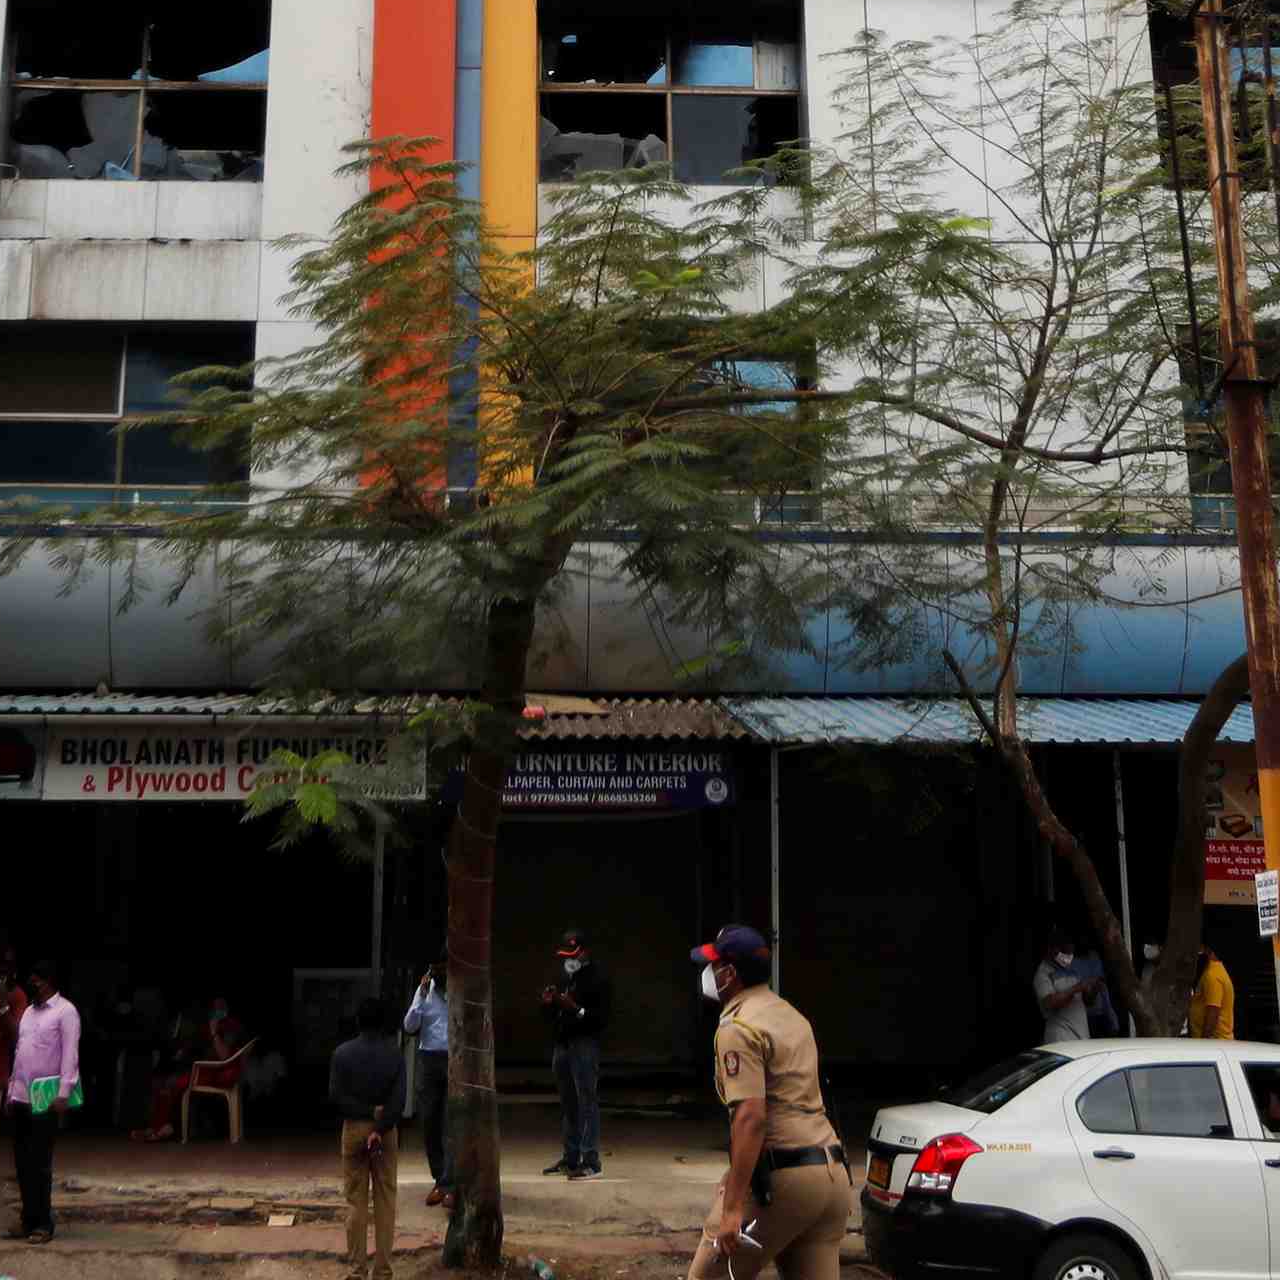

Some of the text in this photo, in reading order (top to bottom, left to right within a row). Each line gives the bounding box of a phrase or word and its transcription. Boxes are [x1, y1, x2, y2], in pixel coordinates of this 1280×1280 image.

[60, 738, 225, 765] BHOLANATH
[516, 753, 722, 773] URNITURE INTERIOR
[82, 775, 96, 792] &
[107, 766, 225, 798] Plywood
[505, 776, 687, 790] LPAPER, CURTAIN AND CARPETS
